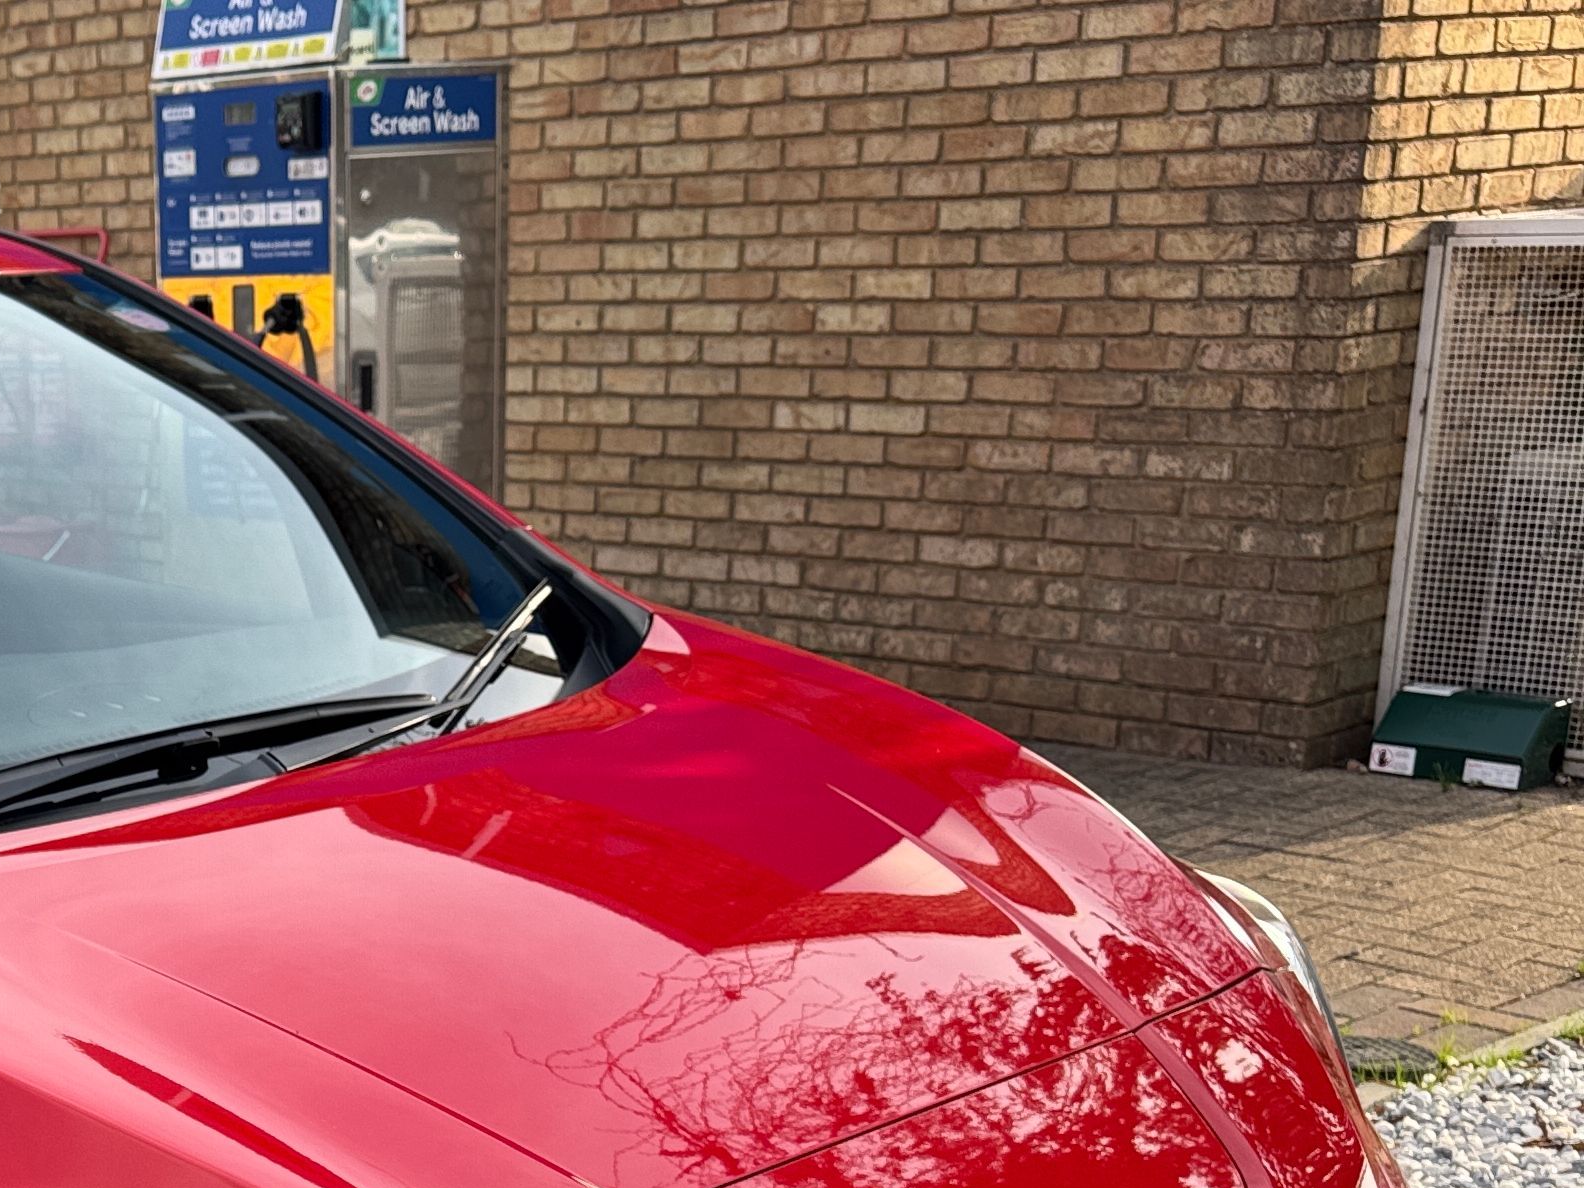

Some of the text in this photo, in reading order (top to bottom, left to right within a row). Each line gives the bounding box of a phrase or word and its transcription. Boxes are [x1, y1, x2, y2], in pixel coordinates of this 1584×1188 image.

[189, 3, 307, 40] Screen Wash
[404, 84, 446, 110] Air &
[370, 107, 480, 136] Screen Wash
